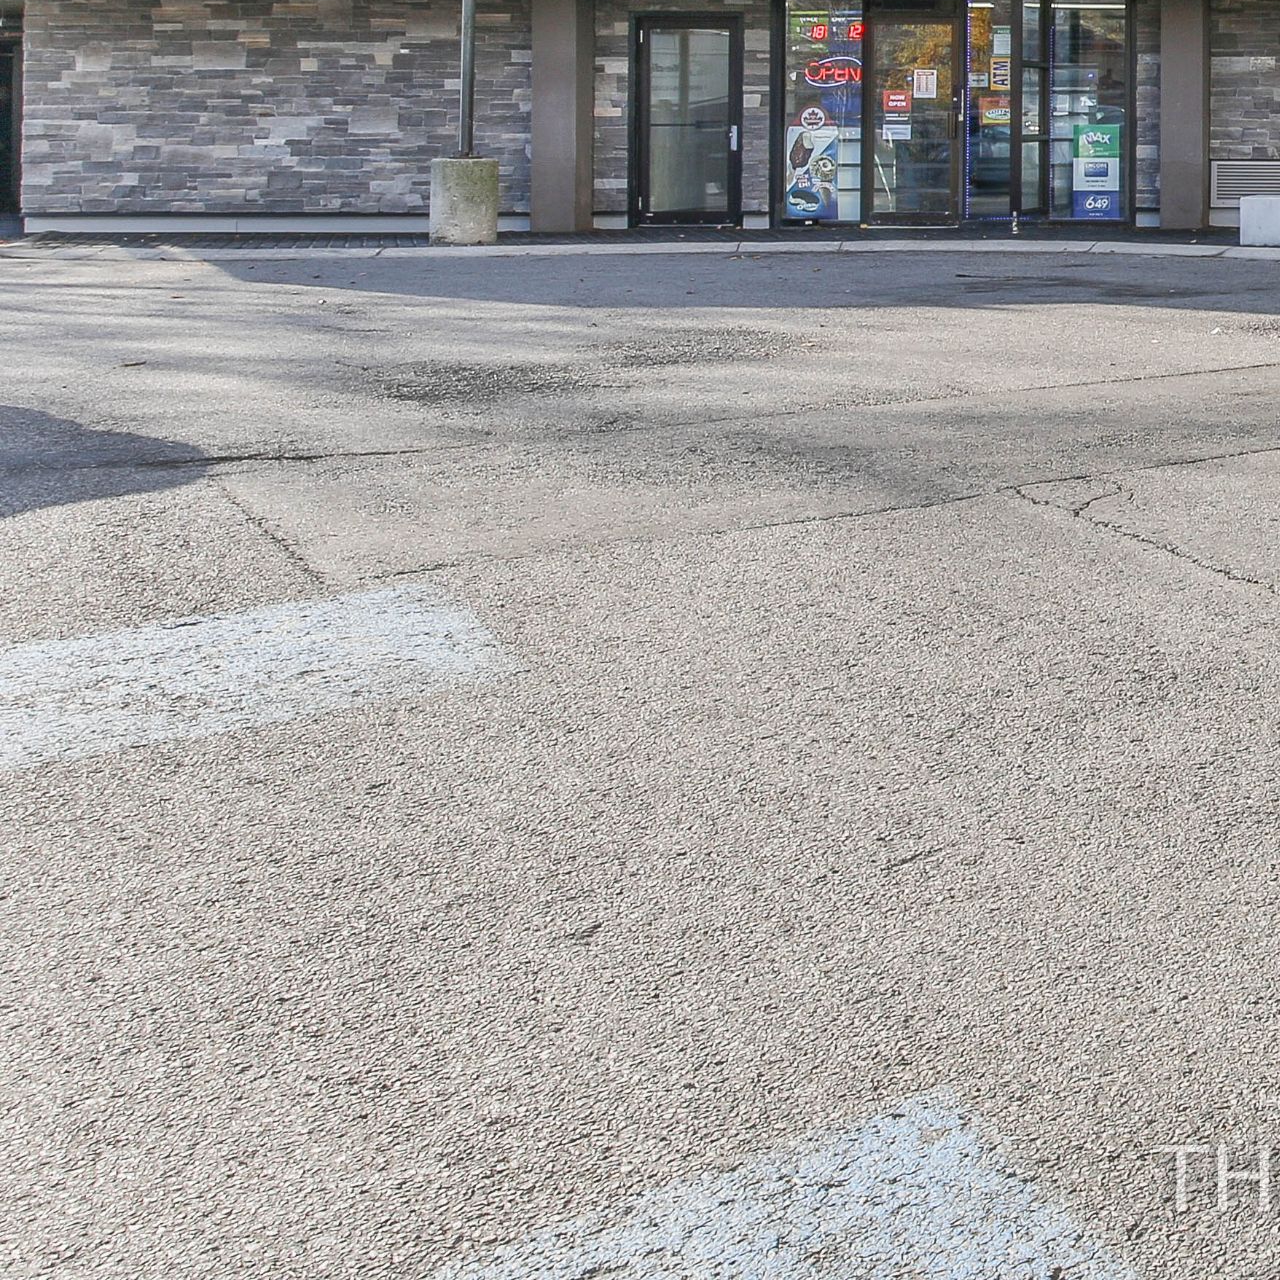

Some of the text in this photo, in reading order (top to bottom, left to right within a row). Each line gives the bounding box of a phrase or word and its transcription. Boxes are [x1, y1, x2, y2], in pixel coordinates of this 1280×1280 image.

[805, 62, 861, 81] OPEN
[993, 61, 1008, 86] ATM
[1082, 132, 1111, 145] MAX
[1085, 196, 1109, 209] 649
